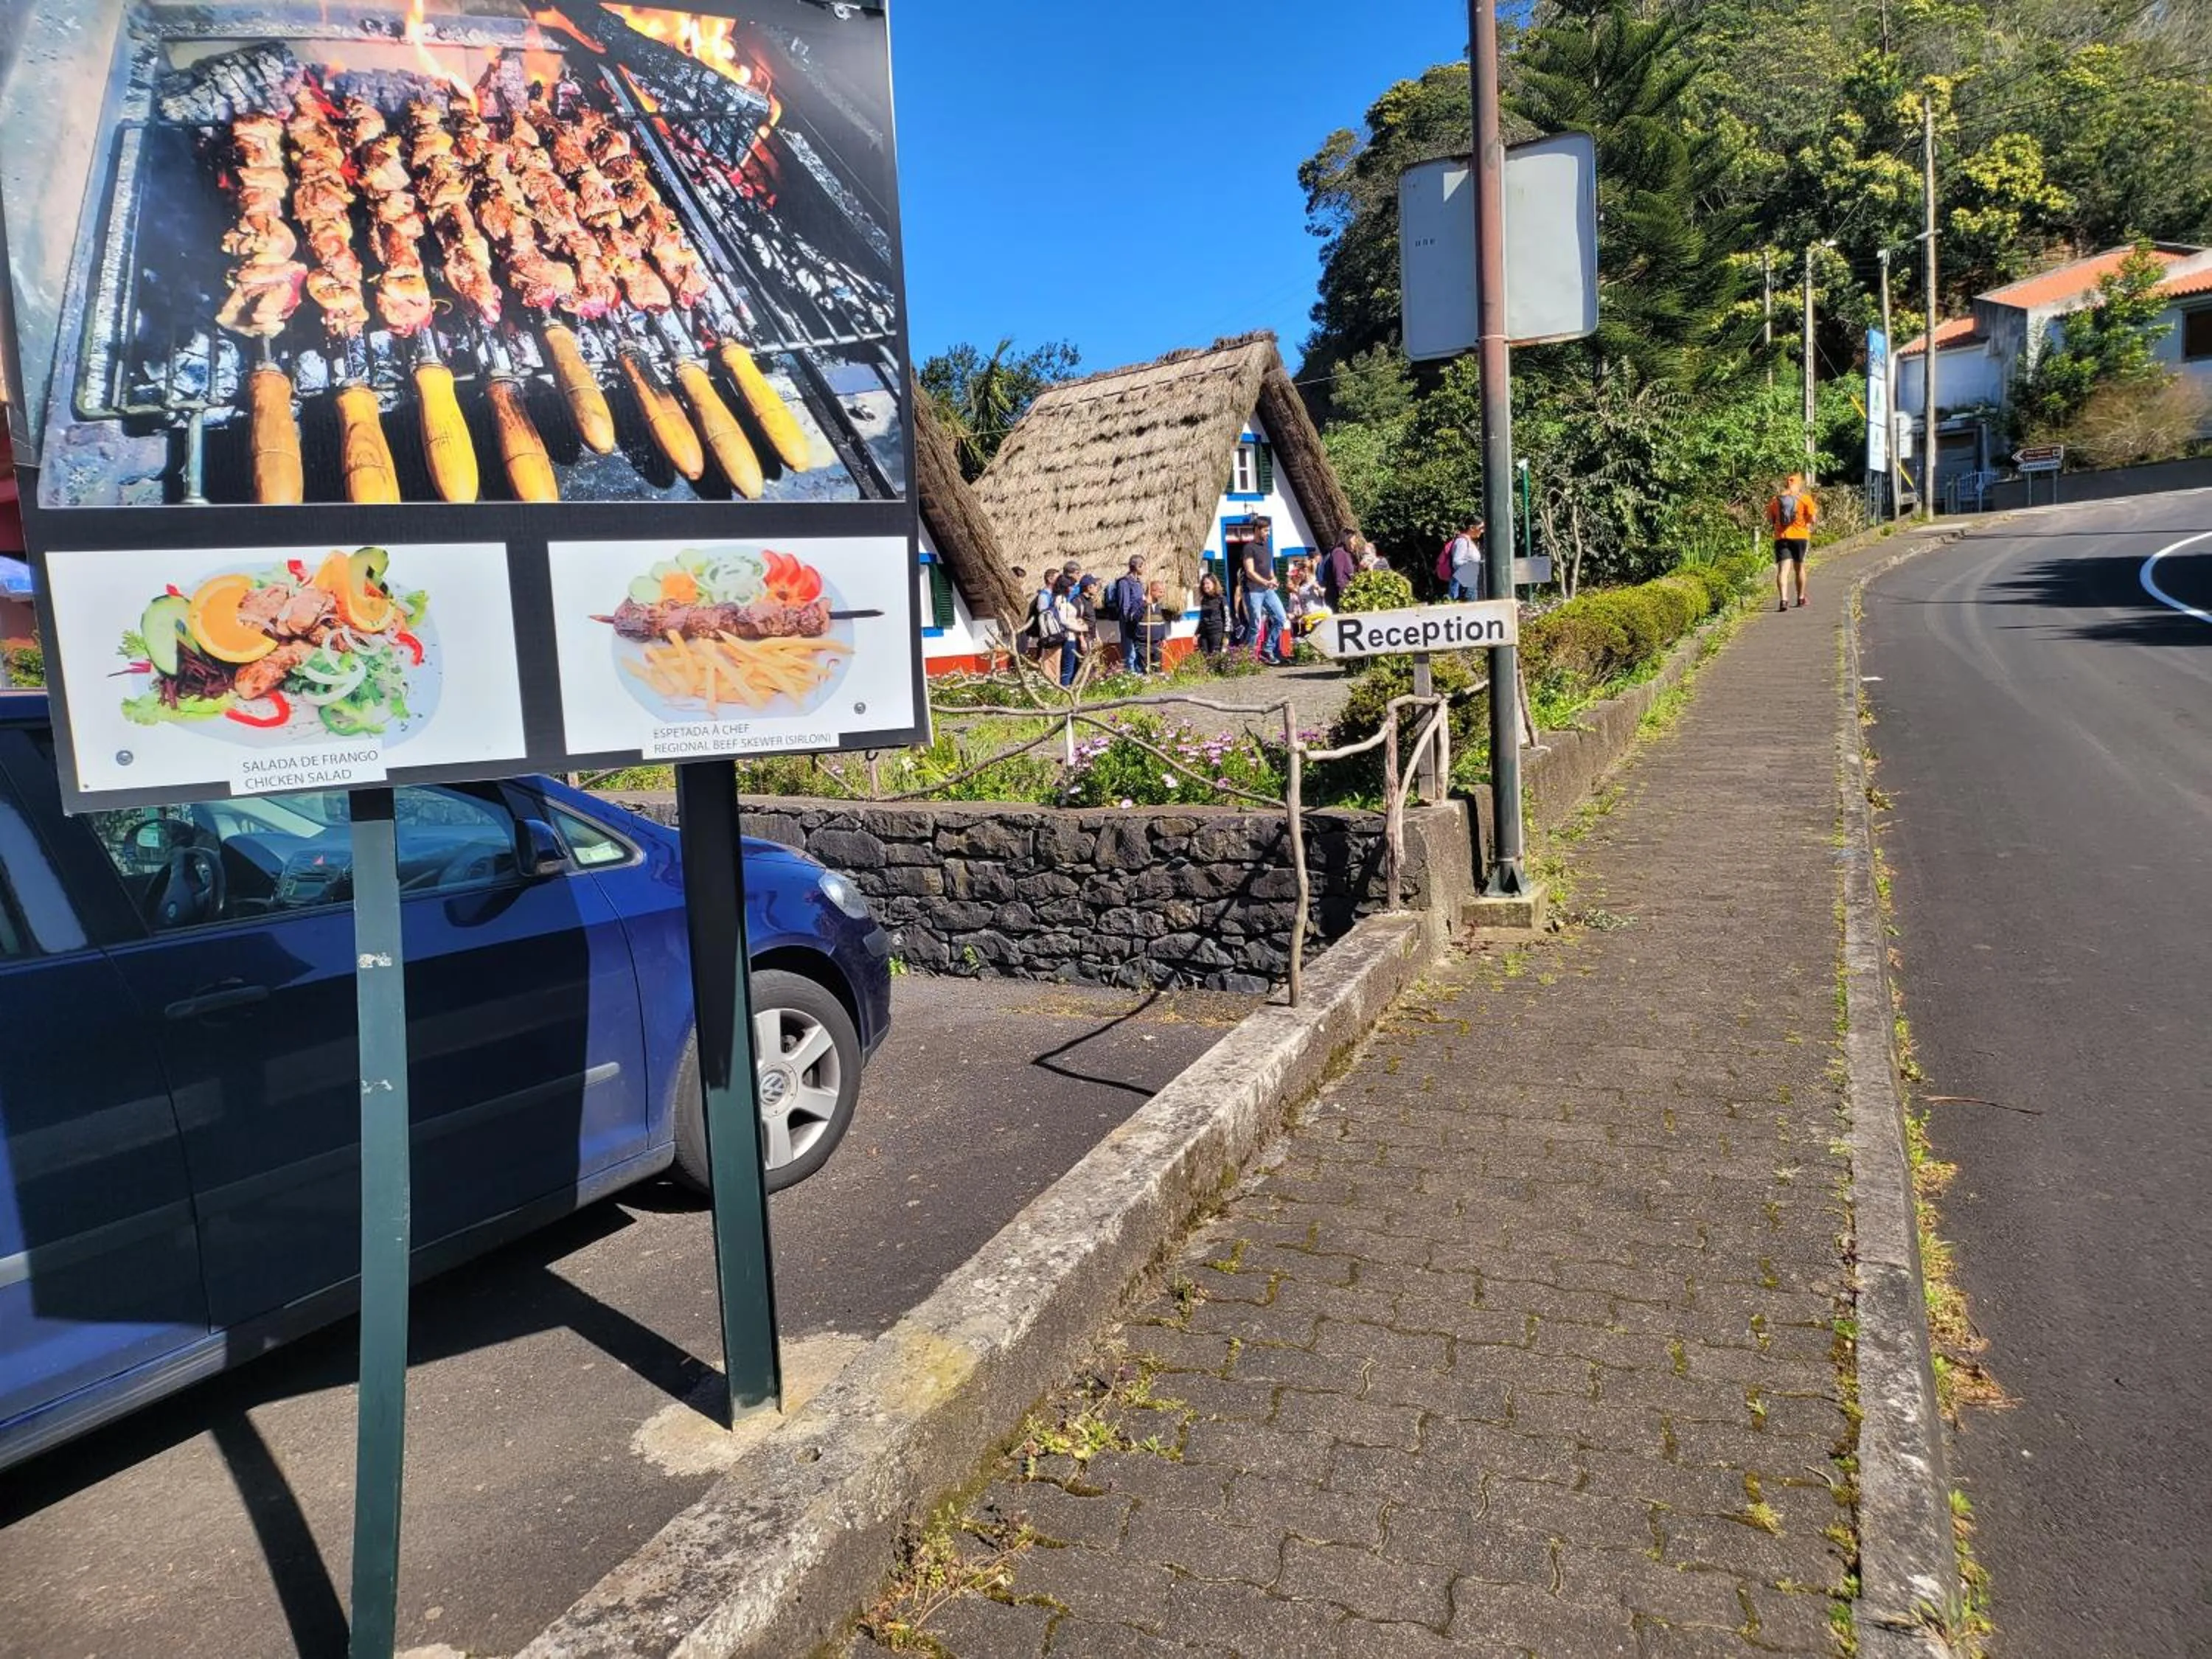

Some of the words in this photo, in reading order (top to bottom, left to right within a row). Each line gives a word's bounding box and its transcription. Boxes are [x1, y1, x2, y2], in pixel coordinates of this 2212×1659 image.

[1338, 616, 1504, 653] Reception
[653, 726, 709, 739] ESPETADA
[722, 723, 751, 735] CHEF
[654, 741, 709, 754] REGIONAL
[713, 739, 738, 750] BEEF
[741, 736, 782, 748] SKEWER
[242, 757, 298, 773] SALADA
[300, 756, 319, 768] DE
[322, 750, 378, 765] FRANGO
[245, 774, 304, 789] CHICKEN
[307, 769, 352, 782] SALAD
